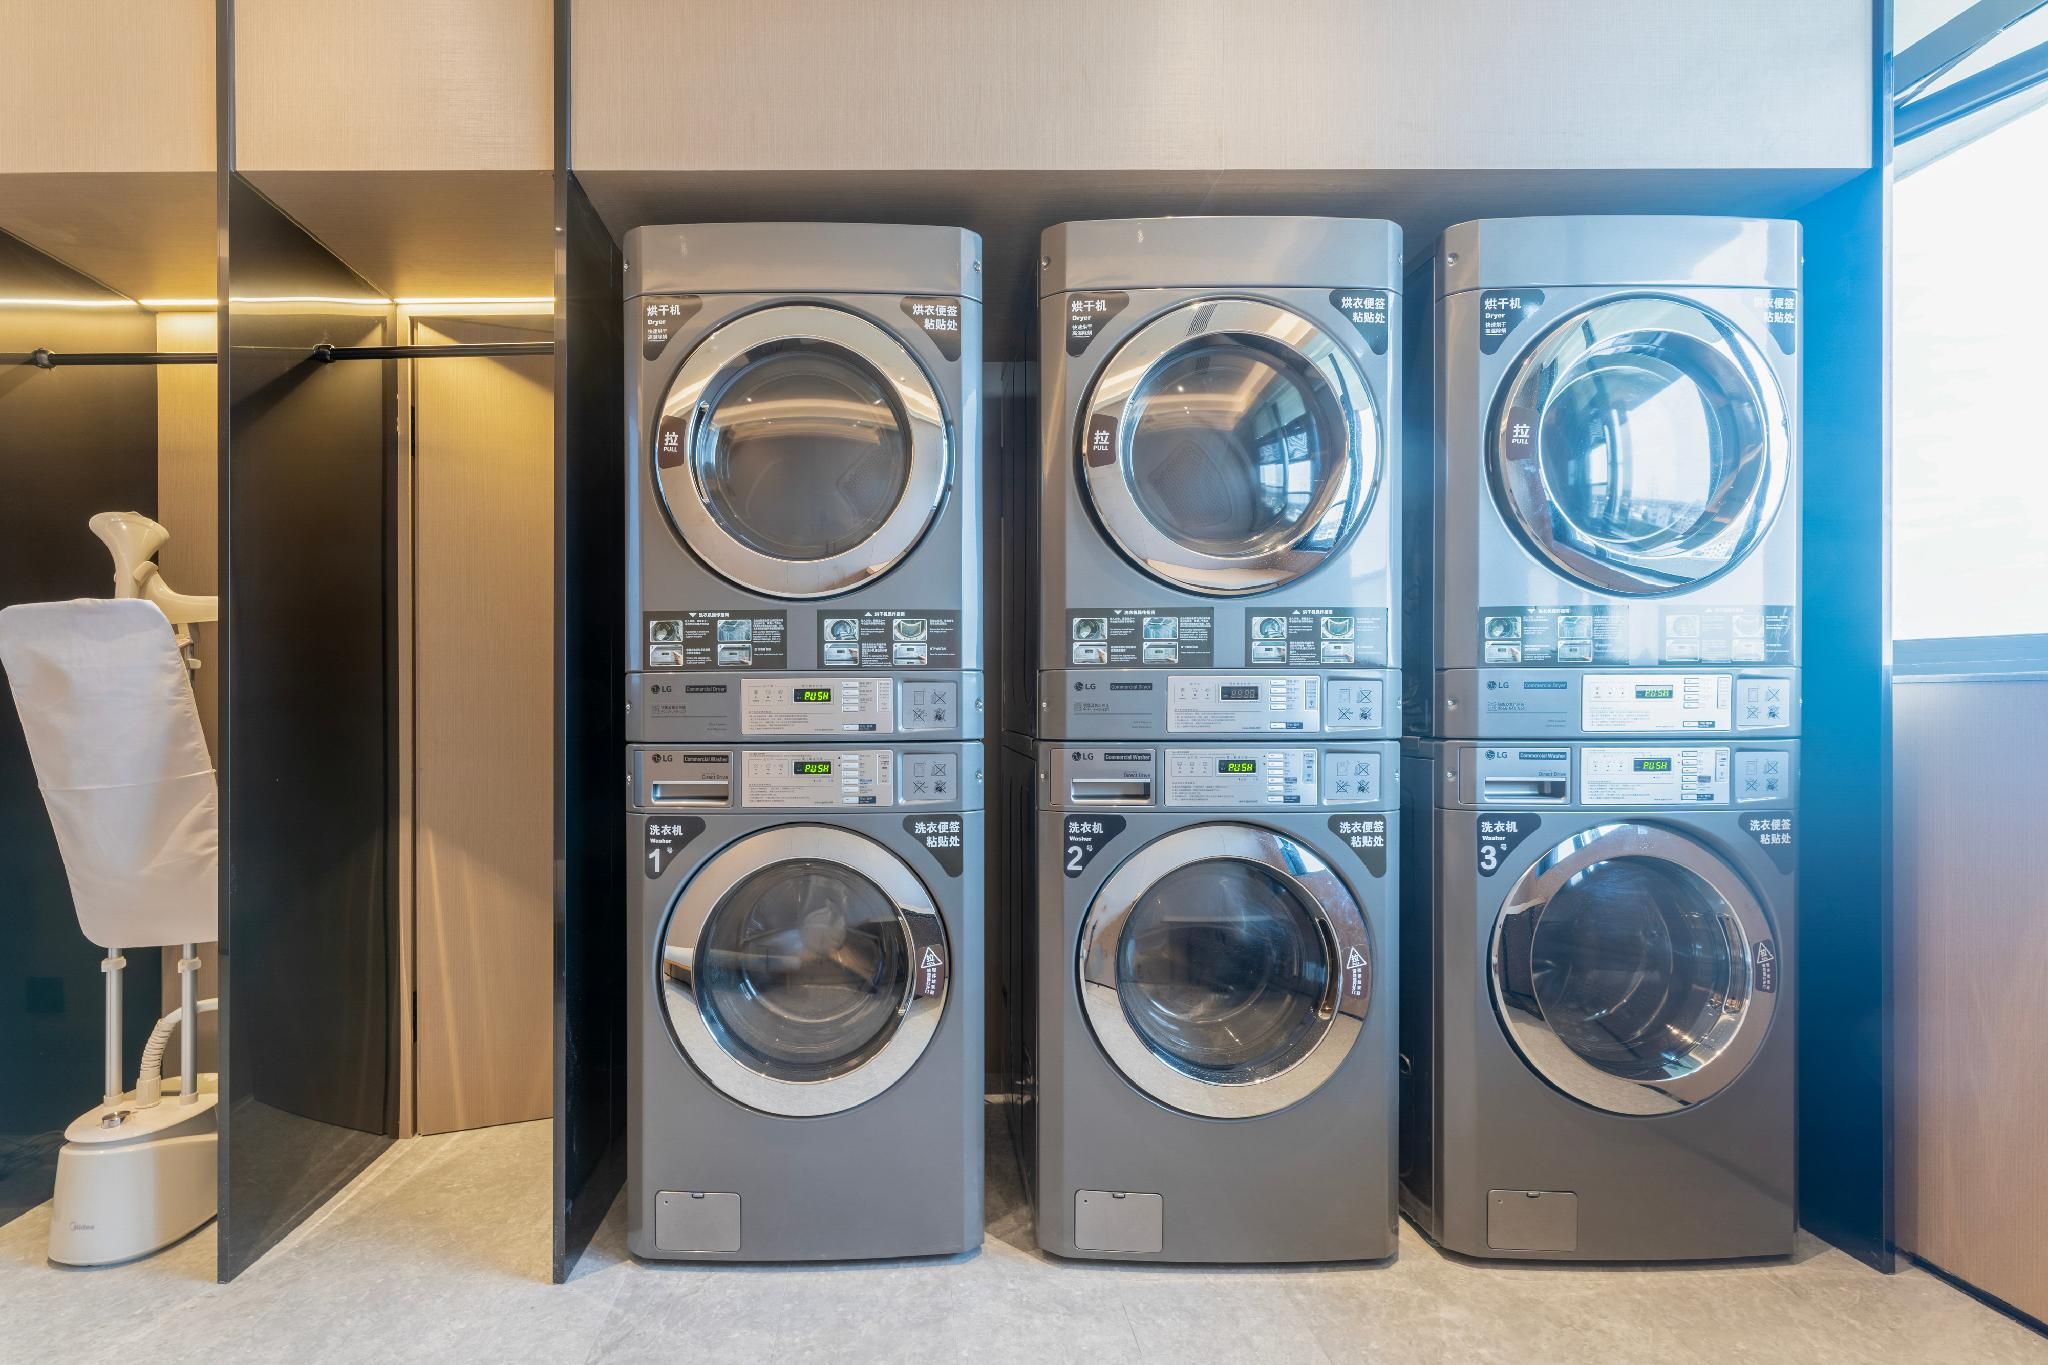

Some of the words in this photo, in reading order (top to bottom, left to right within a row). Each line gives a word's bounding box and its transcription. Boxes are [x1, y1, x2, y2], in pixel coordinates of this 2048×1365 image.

[1071, 300, 1106, 312] 烘干机
[1341, 297, 1385, 309] 烘衣便签
[1484, 298, 1521, 310] 烘干机
[646, 304, 680, 316] 烘干机
[912, 303, 957, 316] 烘衣便签
[1352, 312, 1385, 323] 粘贴处
[924, 318, 957, 330] 粘贴处
[1512, 423, 1530, 437] 拉
[664, 432, 678, 446] 拉
[1093, 430, 1109, 444] 拉
[804, 691, 829, 700] PUSH
[804, 764, 829, 773] PUSH
[1228, 763, 1253, 772] PUSH
[1643, 761, 1668, 770] PUSH
[649, 825, 683, 836] 洗衣机
[914, 821, 960, 833] 洗衣便签
[1068, 822, 1104, 834] 洗衣机
[1339, 821, 1384, 834] 洗衣便签
[1481, 821, 1518, 832] 洗衣机
[1750, 819, 1791, 830] 洗衣便签
[926, 836, 960, 848] 粘贴处
[1351, 836, 1384, 848] 粘贴处
[1760, 833, 1791, 844] 粘贴处
